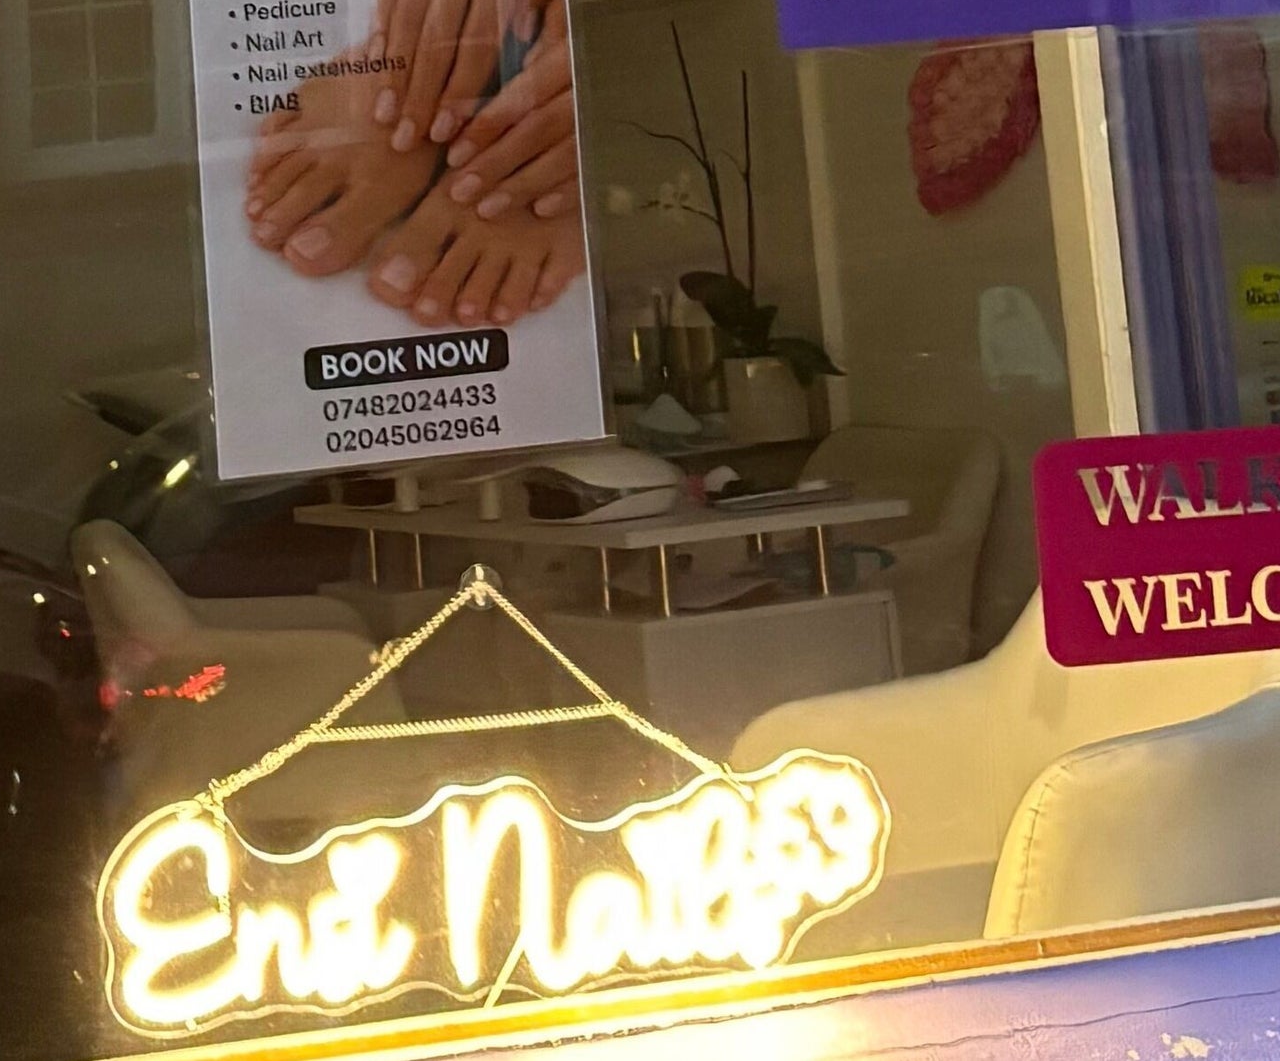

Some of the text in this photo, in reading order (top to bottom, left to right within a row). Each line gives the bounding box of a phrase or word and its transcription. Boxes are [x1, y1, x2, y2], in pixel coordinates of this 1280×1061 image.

[246, 29, 324, 52] Nail Art
[249, 53, 407, 83] Nail extensions
[250, 92, 300, 115] BIAB
[321, 337, 491, 381] BOOK NOW
[323, 383, 498, 422] 07482024433
[326, 415, 502, 453] 02045062964
